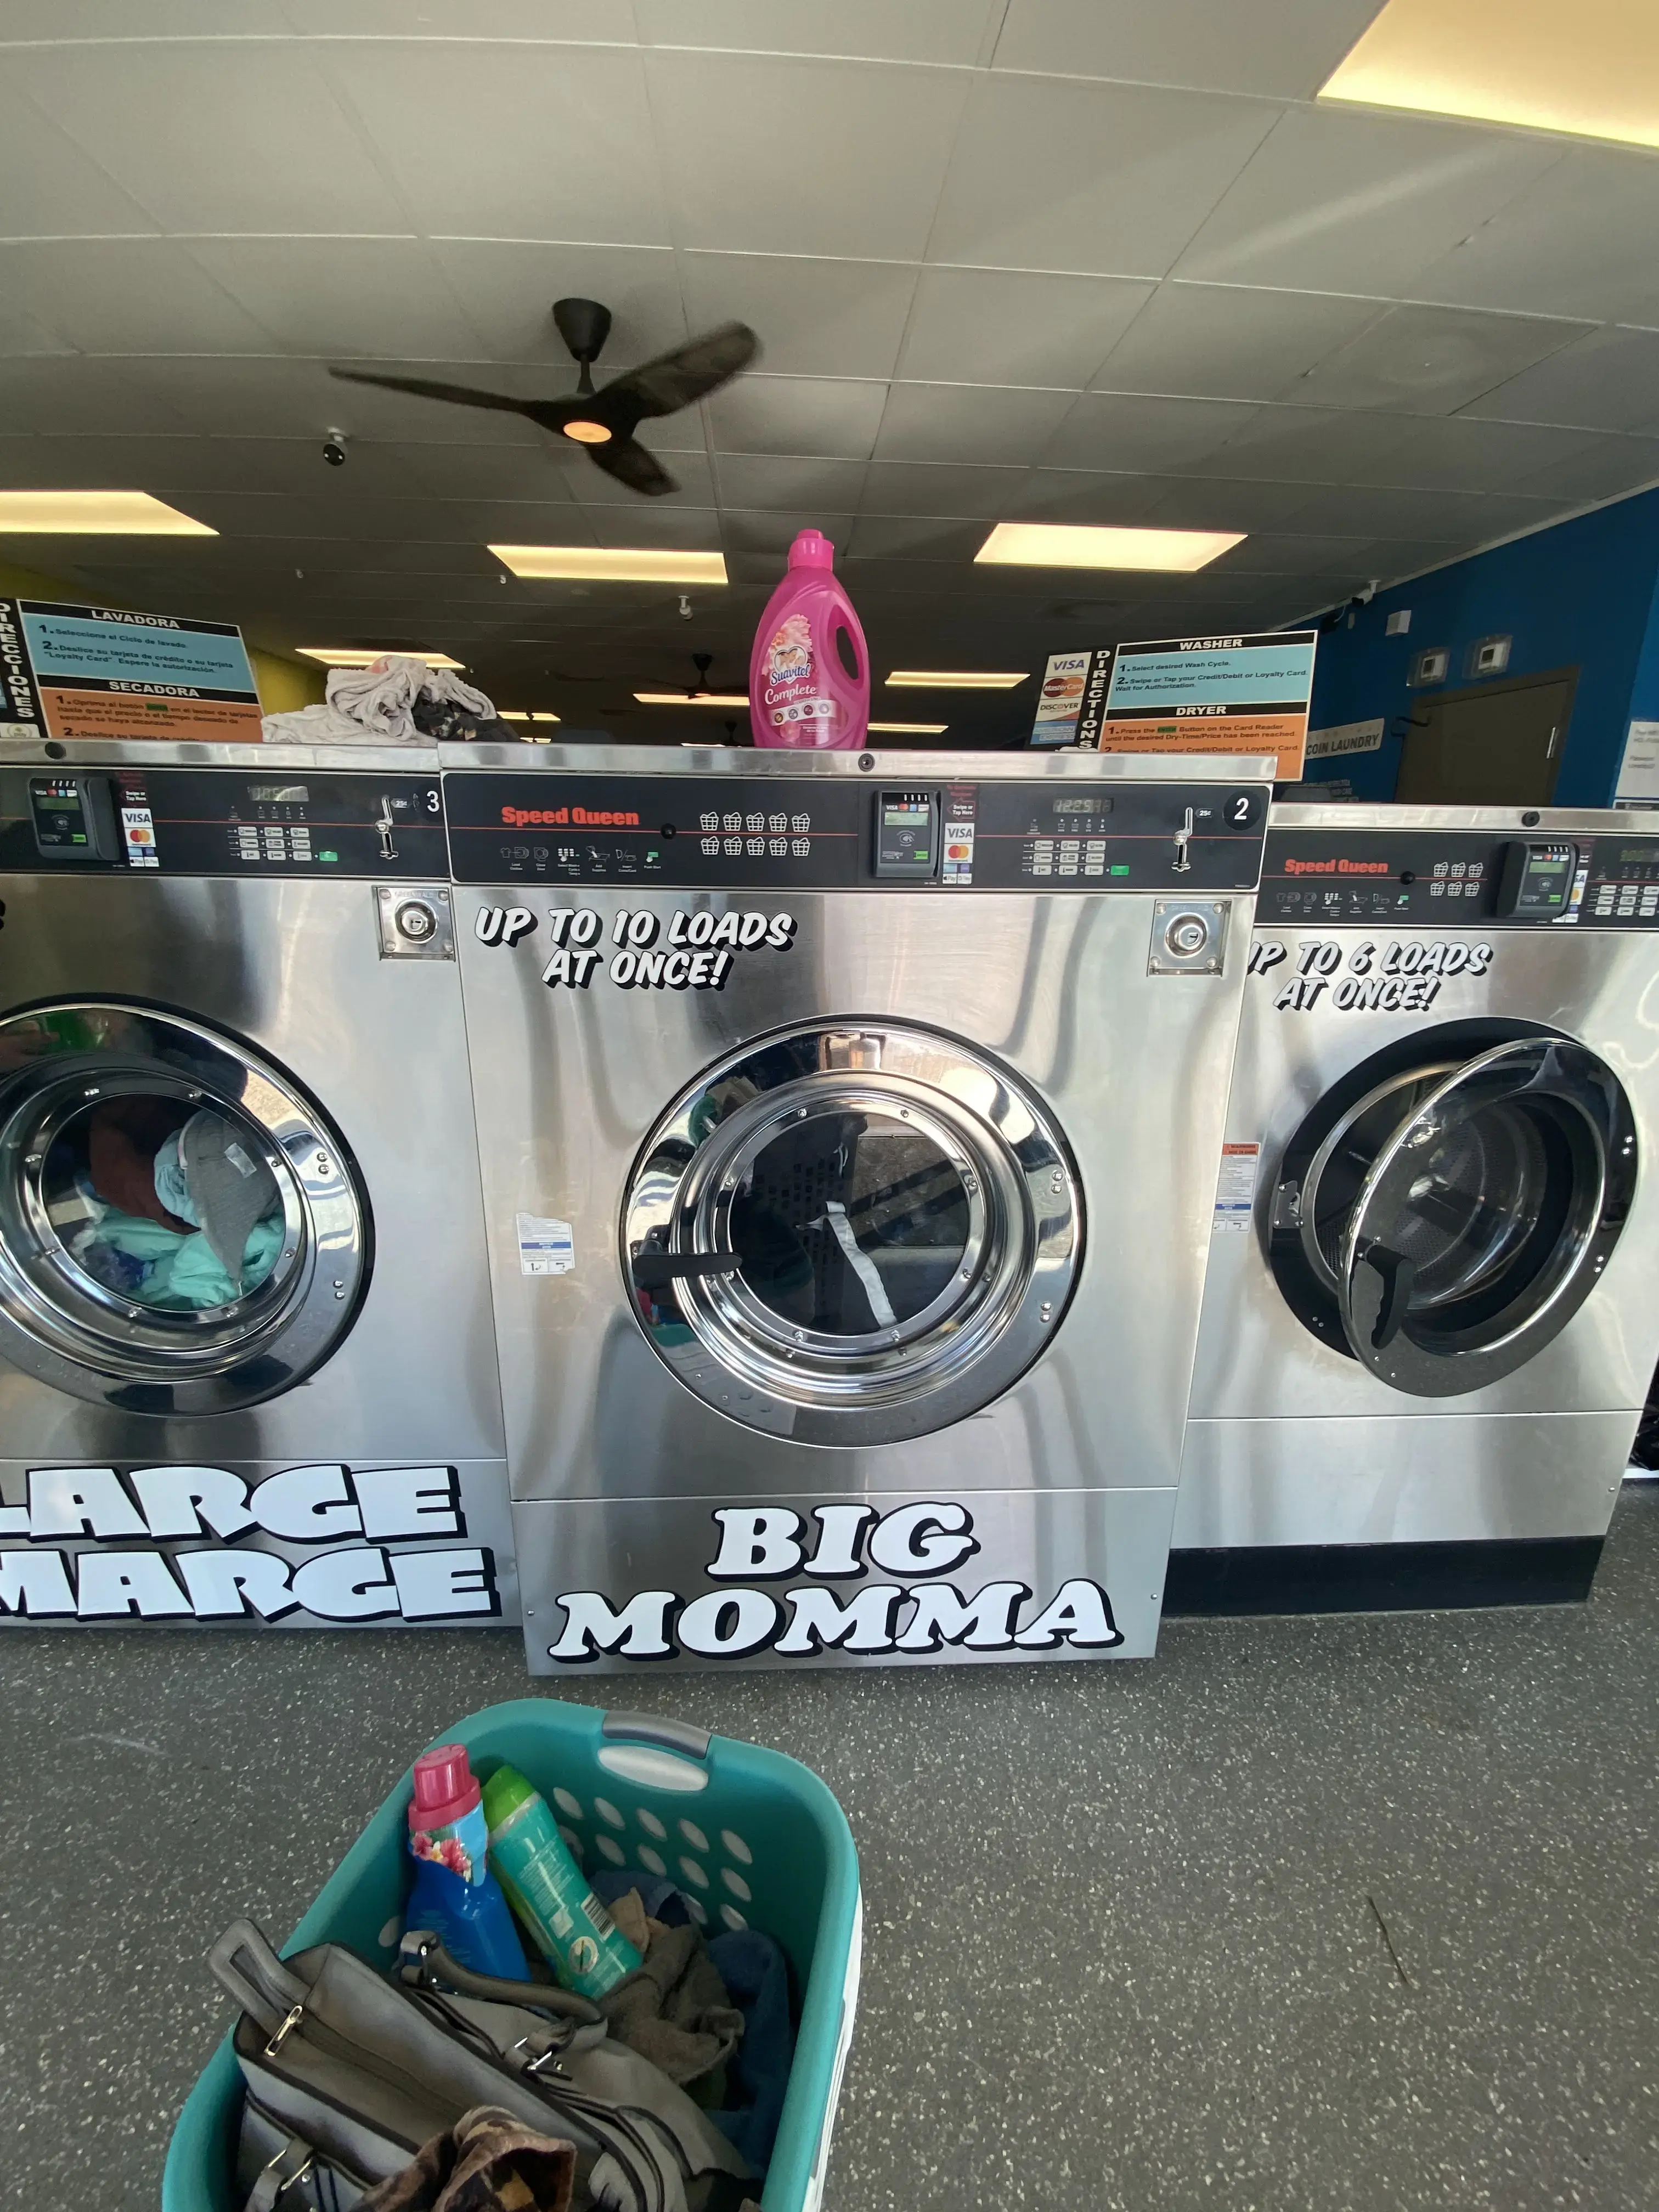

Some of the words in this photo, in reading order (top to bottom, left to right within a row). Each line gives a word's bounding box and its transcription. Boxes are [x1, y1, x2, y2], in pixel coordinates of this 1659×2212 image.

[91, 610, 180, 629] LAVADORA
[55, 629, 106, 639] Seleccione
[59, 645, 93, 653] Deslice
[1180, 638, 1243, 650] WASHER
[119, 658, 149, 667] Espere
[1053, 659, 1085, 671] VISA
[771, 664, 810, 685] Suavitel
[1198, 673, 1244, 681] Credit/Debit
[109, 681, 200, 698] SECADORA
[764, 684, 817, 705] Complete
[1043, 682, 1084, 692] MasterCard
[1040, 703, 1079, 711] DISCOVER
[1079, 650, 1111, 749] DIRECTIONS
[1176, 706, 1227, 716] DRYER
[1306, 741, 1329, 755] COIN
[1331, 733, 1380, 752] LAUNDRY
[426, 790, 440, 812] 3
[1234, 797, 1249, 820] 2
[124, 813, 151, 823] VISA
[501, 806, 569, 827] Speed
[572, 807, 640, 826] Queen
[947, 828, 973, 838] VISA
[1284, 859, 1336, 875] Speed
[1338, 859, 1389, 874] Queen
[475, 906, 539, 947] UP
[548, 907, 603, 948] TO
[611, 909, 659, 949] 10
[667, 910, 798, 952] LOADS
[1296, 941, 1342, 975] TO
[1348, 941, 1376, 975] 6
[1380, 942, 1494, 976] LOADS
[541, 949, 604, 989] AT
[609, 950, 735, 991] ONCE!
[1272, 977, 1329, 1011] AT
[1332, 977, 1442, 1012] ONCE!
[706, 1501, 982, 1582] BIG
[546, 1578, 1125, 1666] MOMMA
